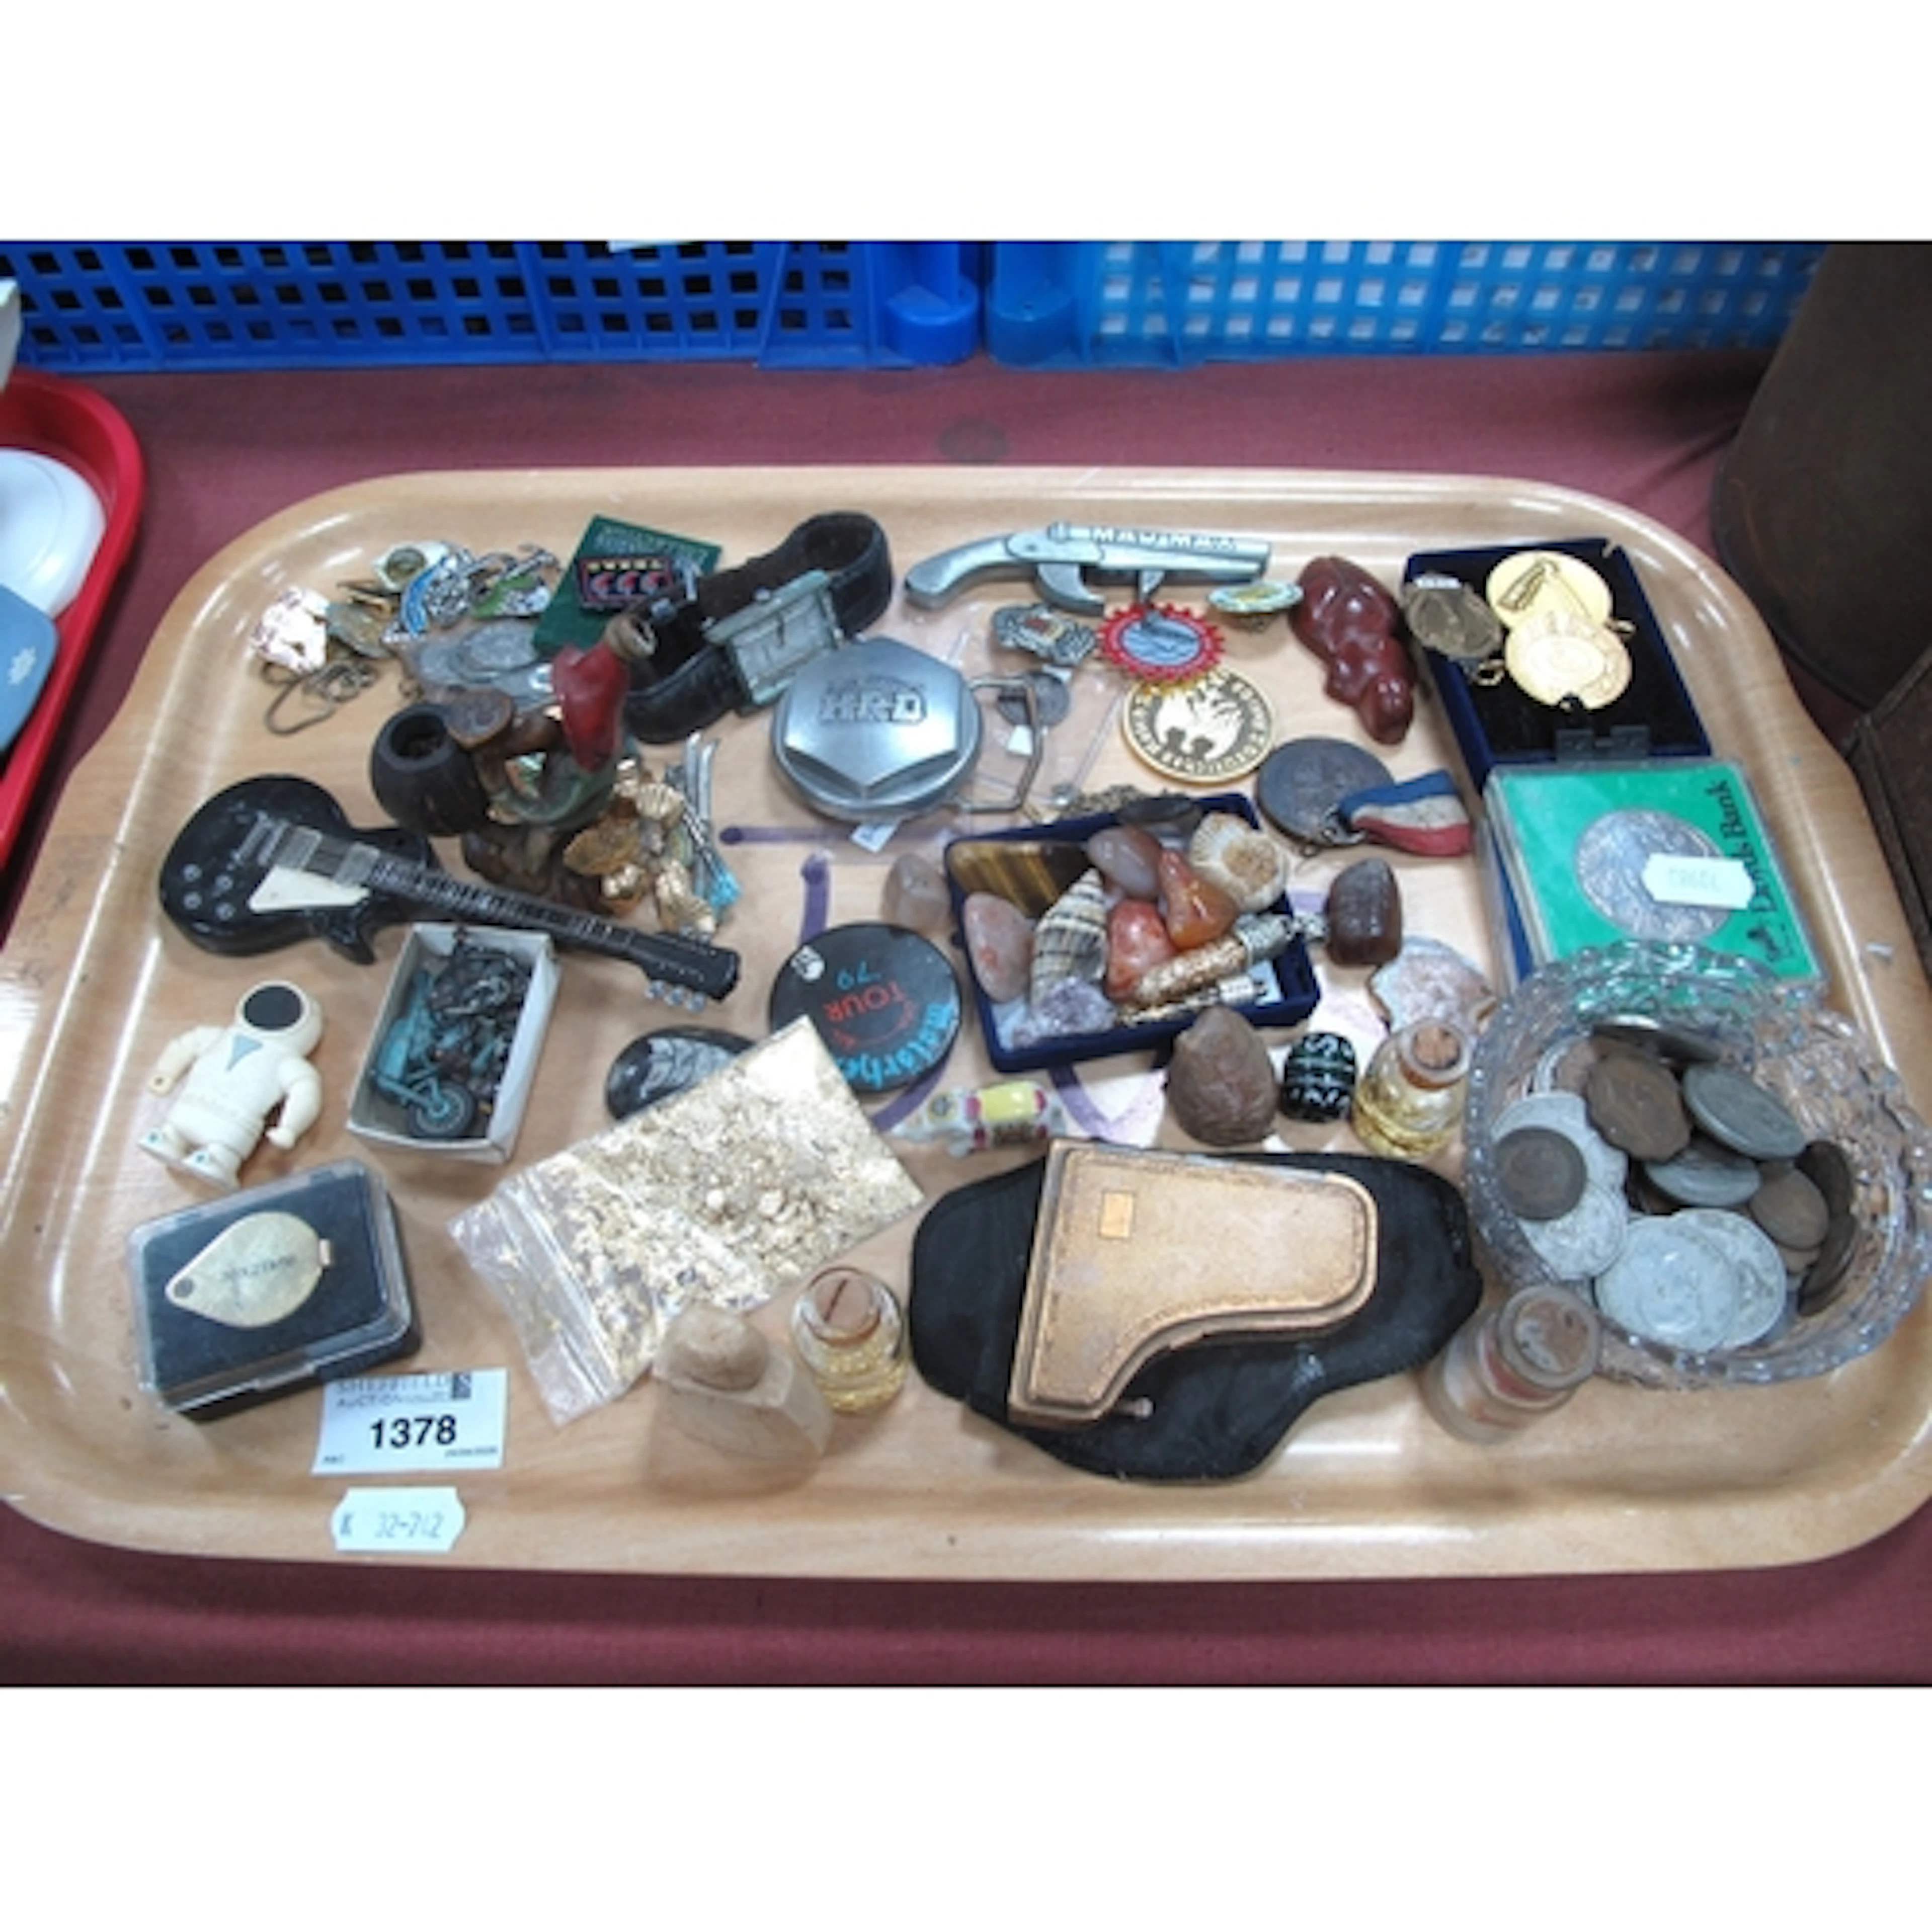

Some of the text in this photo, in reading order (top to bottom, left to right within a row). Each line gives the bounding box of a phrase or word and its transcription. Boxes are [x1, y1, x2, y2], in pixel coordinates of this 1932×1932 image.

[1705, 780, 1747, 839] Bank
[823, 979, 906, 1023] TOUR
[371, 1415, 456, 1448] 1378
